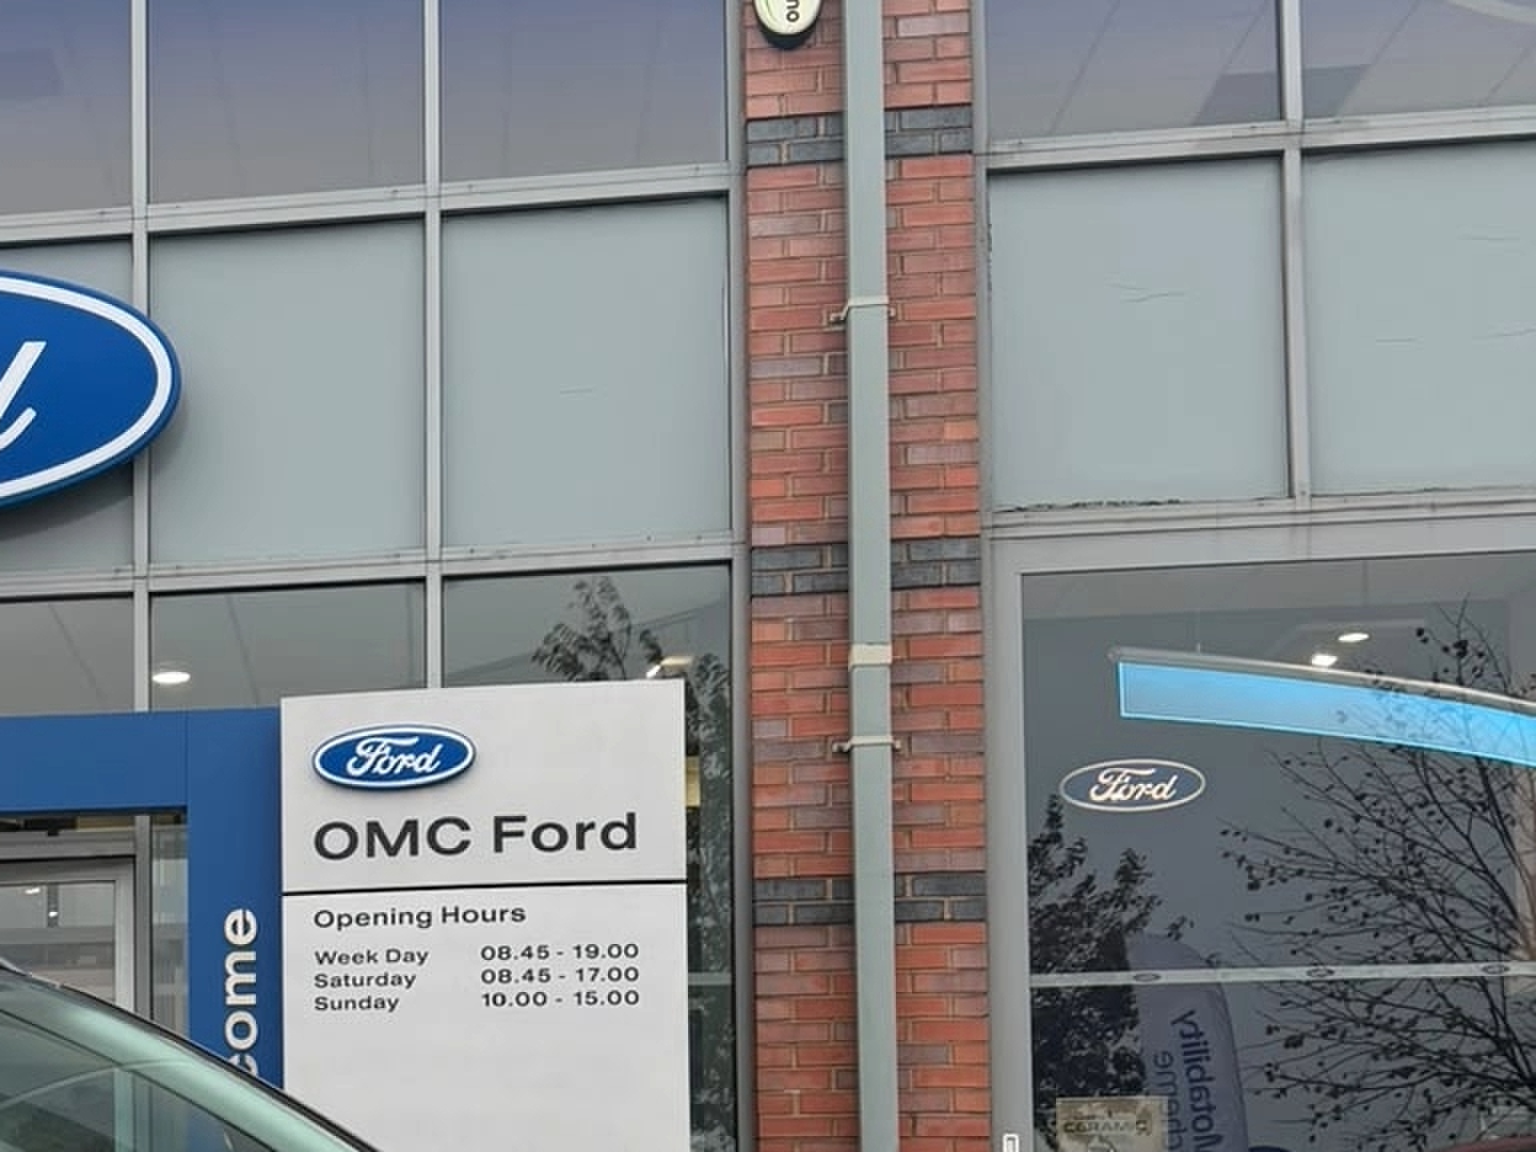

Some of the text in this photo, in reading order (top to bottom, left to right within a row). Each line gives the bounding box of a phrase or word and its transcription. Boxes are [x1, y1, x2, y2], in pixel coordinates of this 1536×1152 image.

[346, 736, 441, 778] Ford
[1089, 766, 1177, 802] Ford
[313, 812, 638, 861] OMC Ford
[314, 906, 527, 931] Opening Hours
[314, 949, 379, 965] Week
[385, 948, 429, 966] Day
[480, 944, 550, 961] 08.45
[573, 943, 640, 960] 19.00
[314, 972, 417, 989] Saturday
[480, 968, 552, 984] 08.45
[575, 966, 640, 983] 17.00
[314, 995, 400, 1013] Sunday
[482, 991, 548, 1007] 10.00
[573, 989, 640, 1006] 15.00
